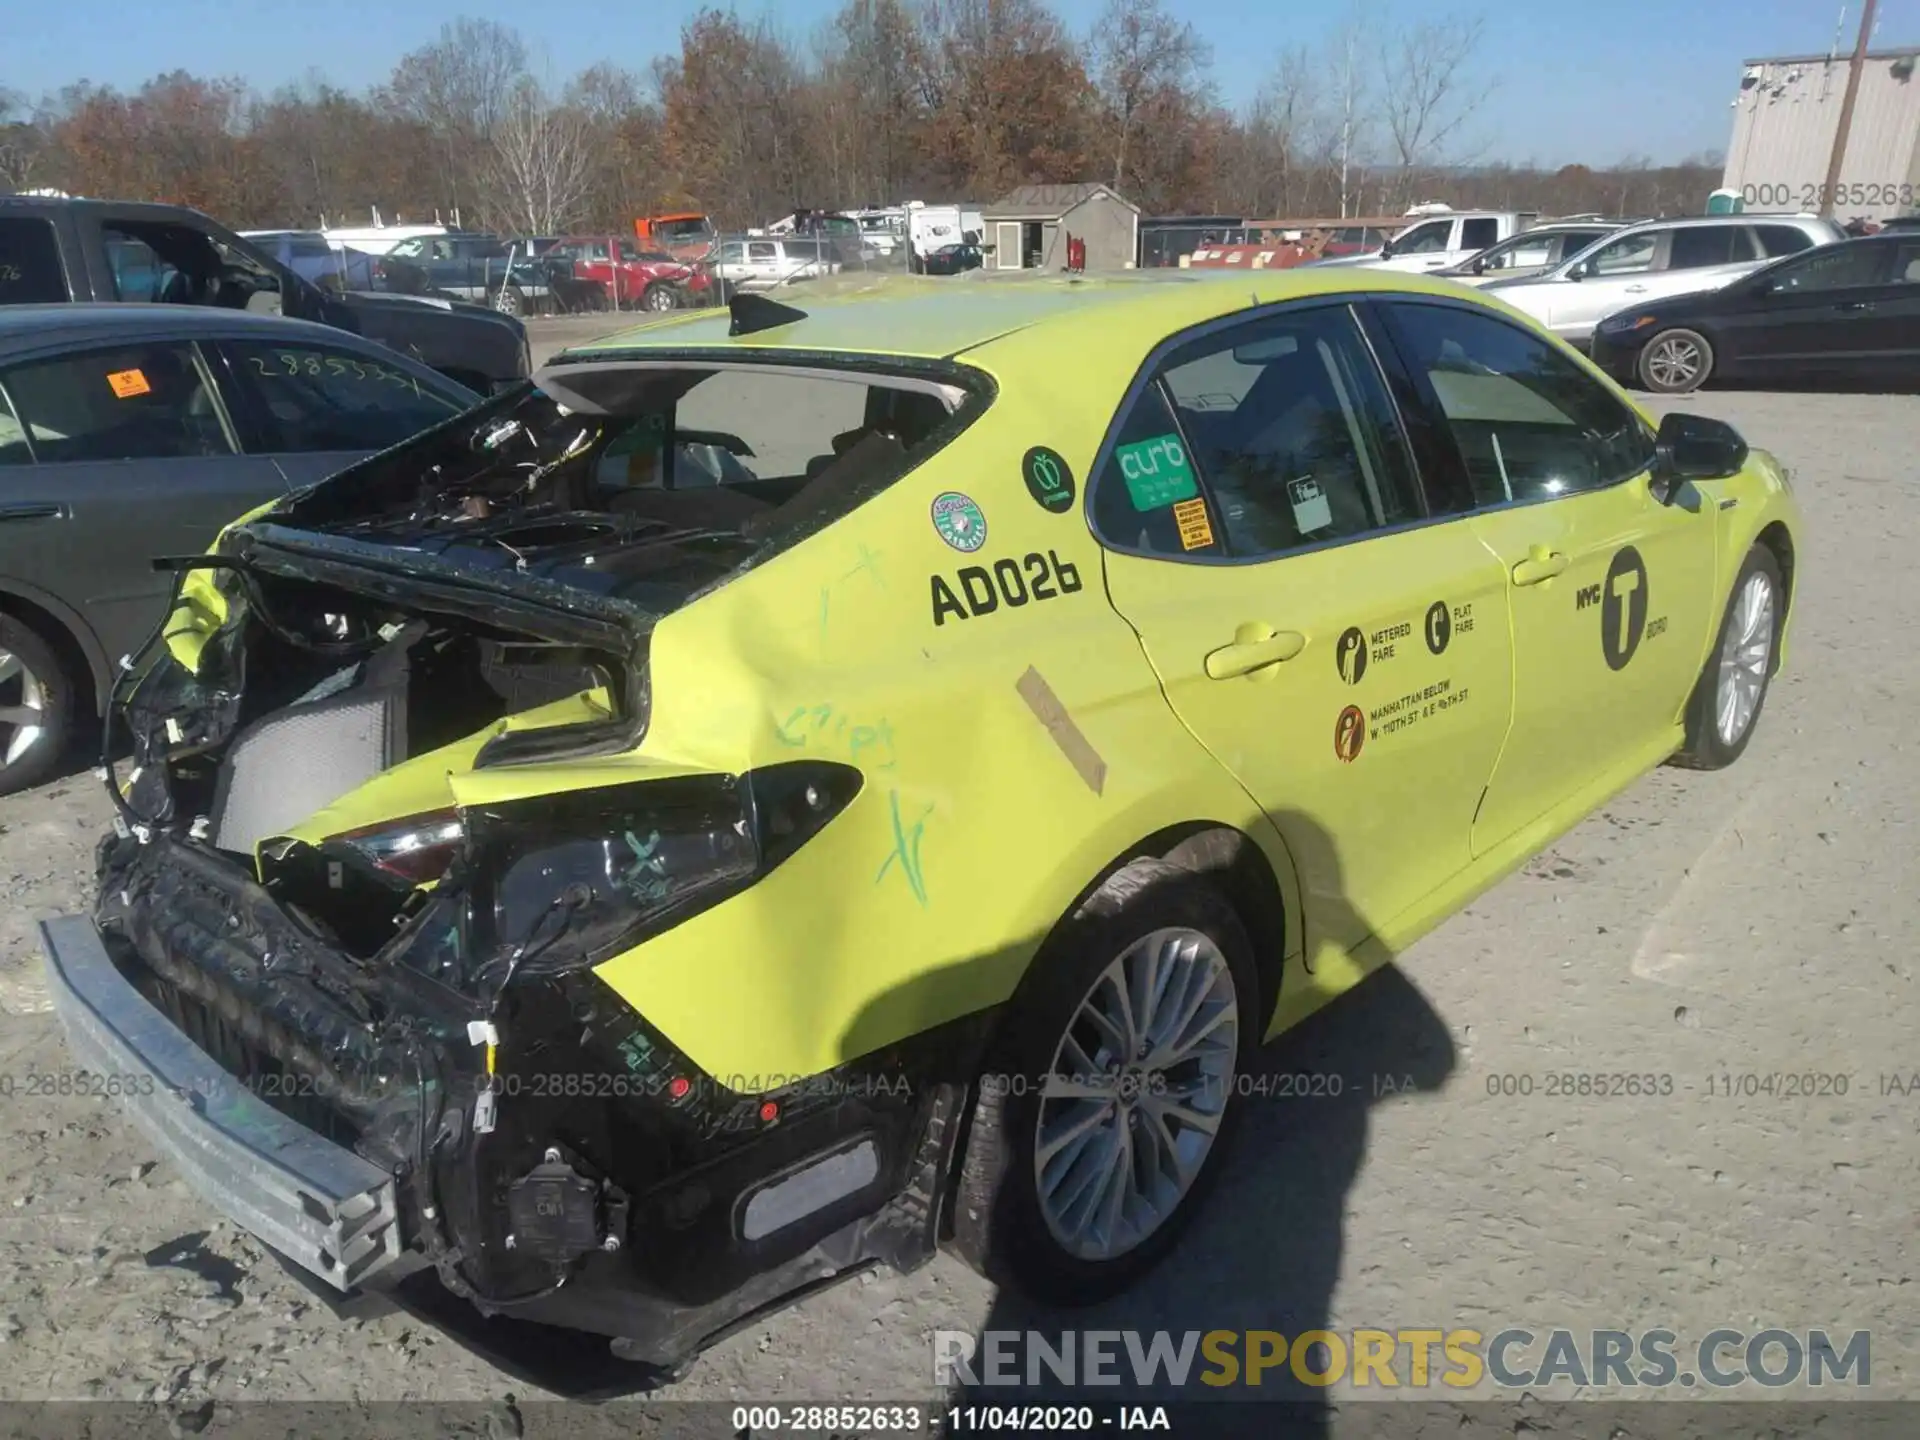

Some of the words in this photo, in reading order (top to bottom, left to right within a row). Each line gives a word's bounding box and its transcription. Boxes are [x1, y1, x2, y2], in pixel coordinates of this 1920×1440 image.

[1120, 440, 1185, 479] curb
[1576, 583, 1600, 610] NYC
[1454, 604, 1471, 620] FLAT
[1371, 623, 1410, 646] METERED
[1456, 619, 1474, 635] FARE
[1372, 645, 1394, 664] FARE
[1370, 691, 1422, 721] MANHATTAN
[1423, 679, 1450, 699] BELOW
